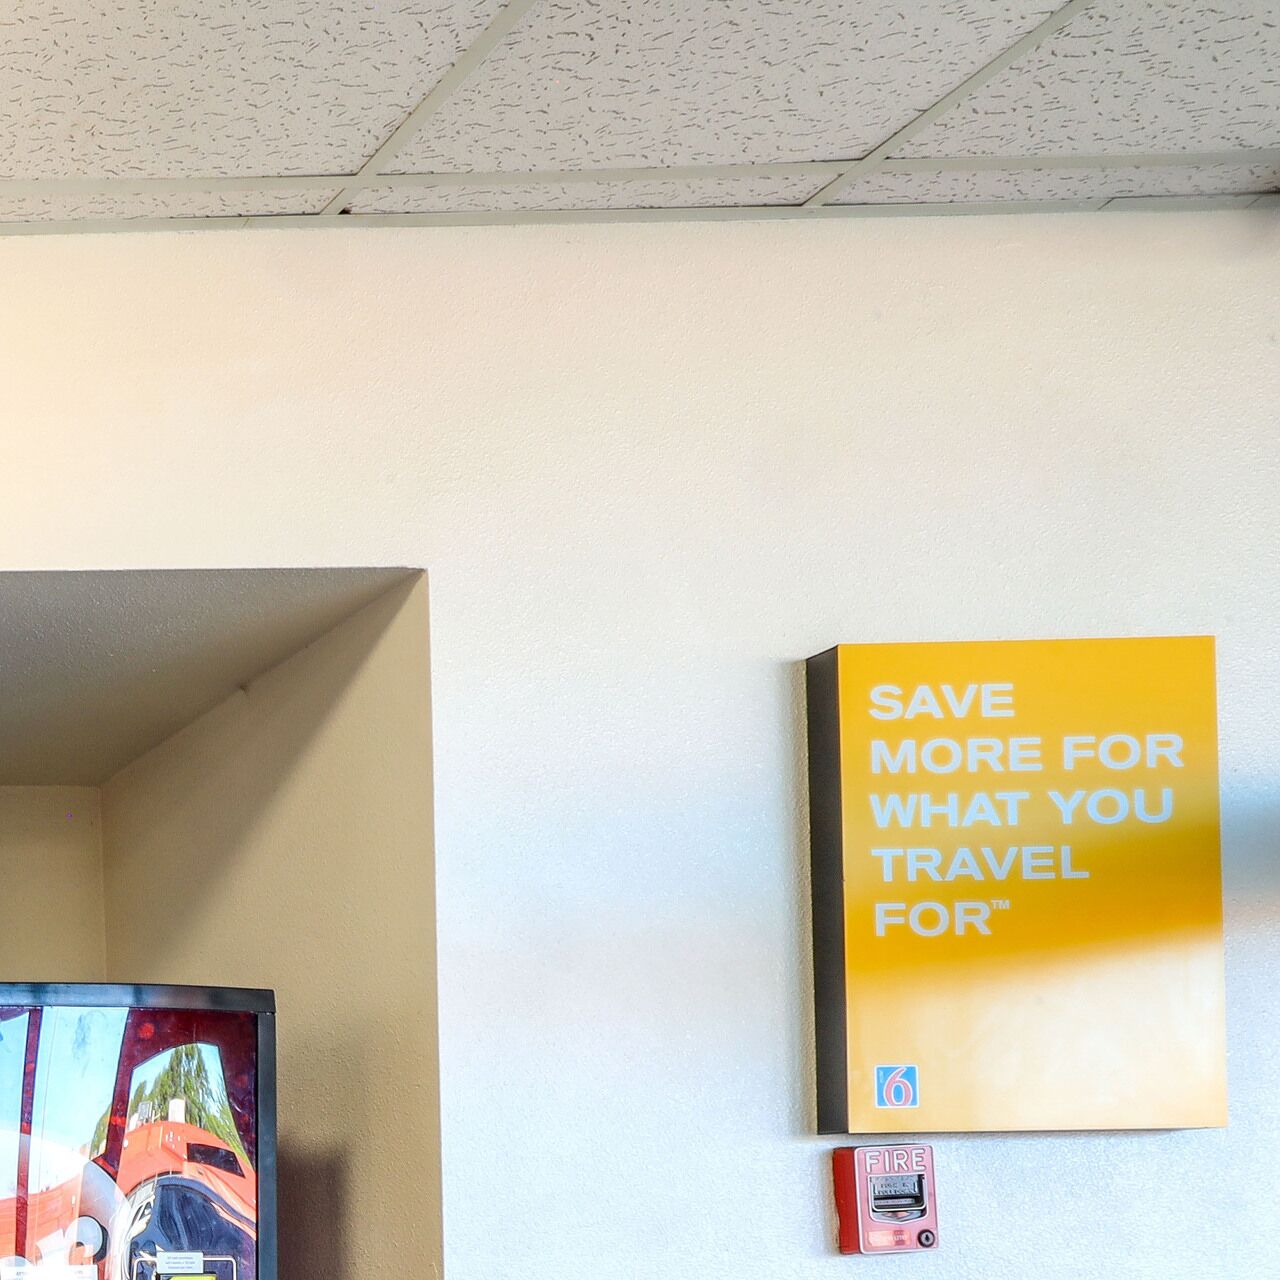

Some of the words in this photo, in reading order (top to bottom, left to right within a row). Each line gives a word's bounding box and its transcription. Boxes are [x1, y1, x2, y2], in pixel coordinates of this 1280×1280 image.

[868, 682, 1015, 721] SAVE
[872, 737, 1042, 775] MORE
[1063, 733, 1185, 771] FOR
[869, 791, 1030, 828] WHAT
[1048, 788, 1174, 826] YOU
[872, 845, 1090, 883] TRAVEL
[883, 1066, 913, 1106] 6
[864, 1149, 927, 1174] FIRE
